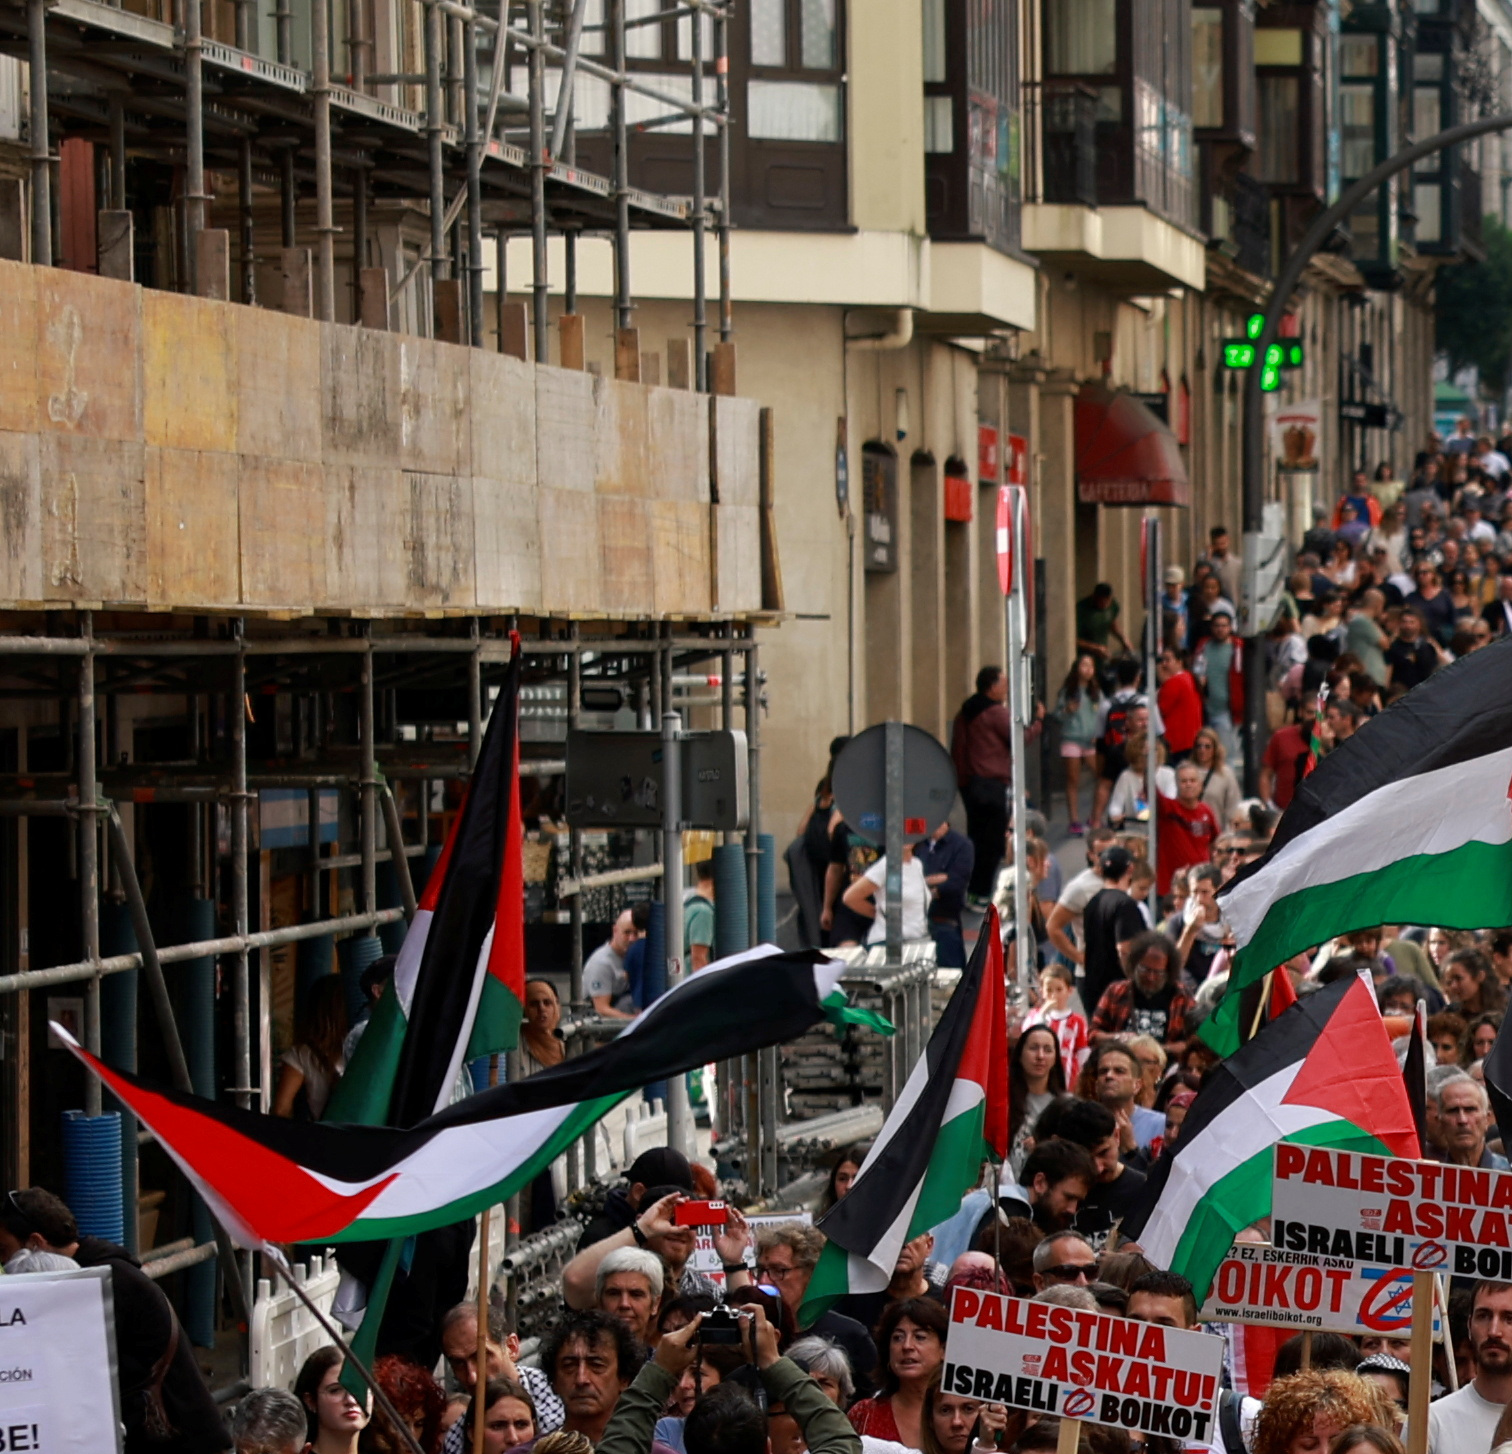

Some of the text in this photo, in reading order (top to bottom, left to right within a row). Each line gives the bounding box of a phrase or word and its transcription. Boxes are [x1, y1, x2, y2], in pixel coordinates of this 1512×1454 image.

[1262, 1249, 1320, 1266] ESKERRIK
[1273, 1219, 1405, 1265] ISRAELI
[1208, 1259, 1353, 1313] OIKOT
[951, 1288, 1166, 1363] PALESTINA
[1215, 1306, 1323, 1327] www.israeliboikot.org
[0, 1366, 33, 1382] CIÓN
[1040, 1345, 1216, 1411] ASKATU!
[943, 1363, 1212, 1441] ISRAELI BOIKOT
